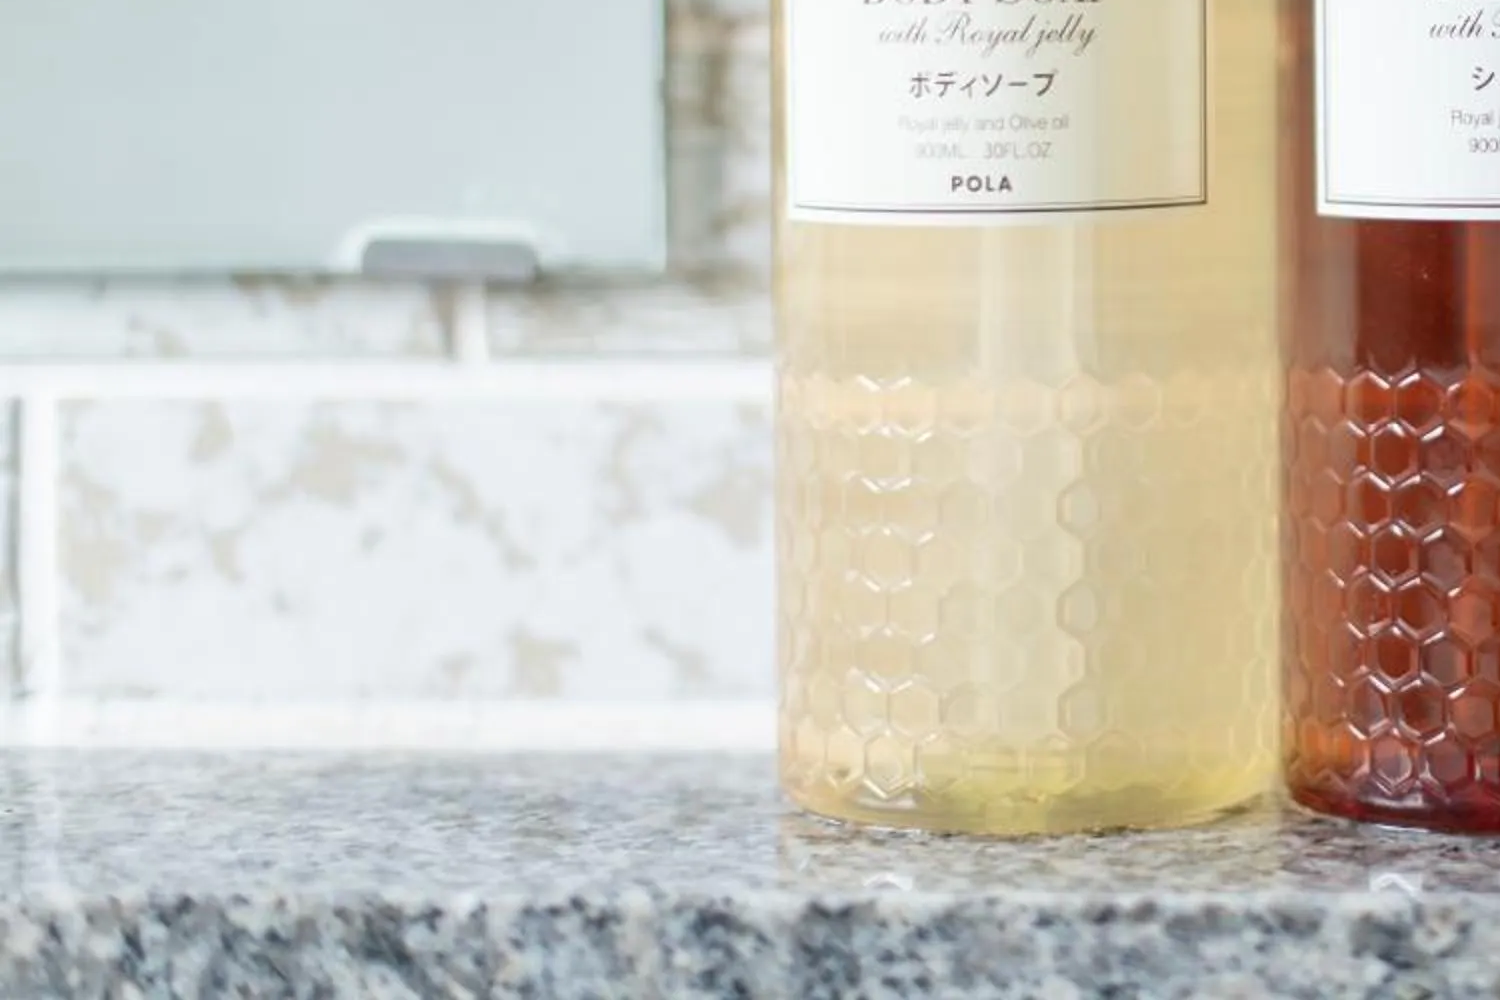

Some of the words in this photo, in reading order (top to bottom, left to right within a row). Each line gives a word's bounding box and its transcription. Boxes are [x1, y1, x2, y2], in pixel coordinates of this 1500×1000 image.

[878, 15, 928, 44] with
[935, 11, 1036, 58] Royal
[1027, 14, 1099, 56] jelly
[1429, 9, 1485, 40] with
[909, 68, 1059, 98] ボディソープ
[898, 115, 939, 135] Royal
[942, 115, 971, 136] jelly
[975, 115, 1004, 132] and
[1009, 115, 1049, 132] Olive
[1052, 115, 1070, 131] oil
[1451, 110, 1493, 128] Royal
[951, 175, 1013, 193] POLA
